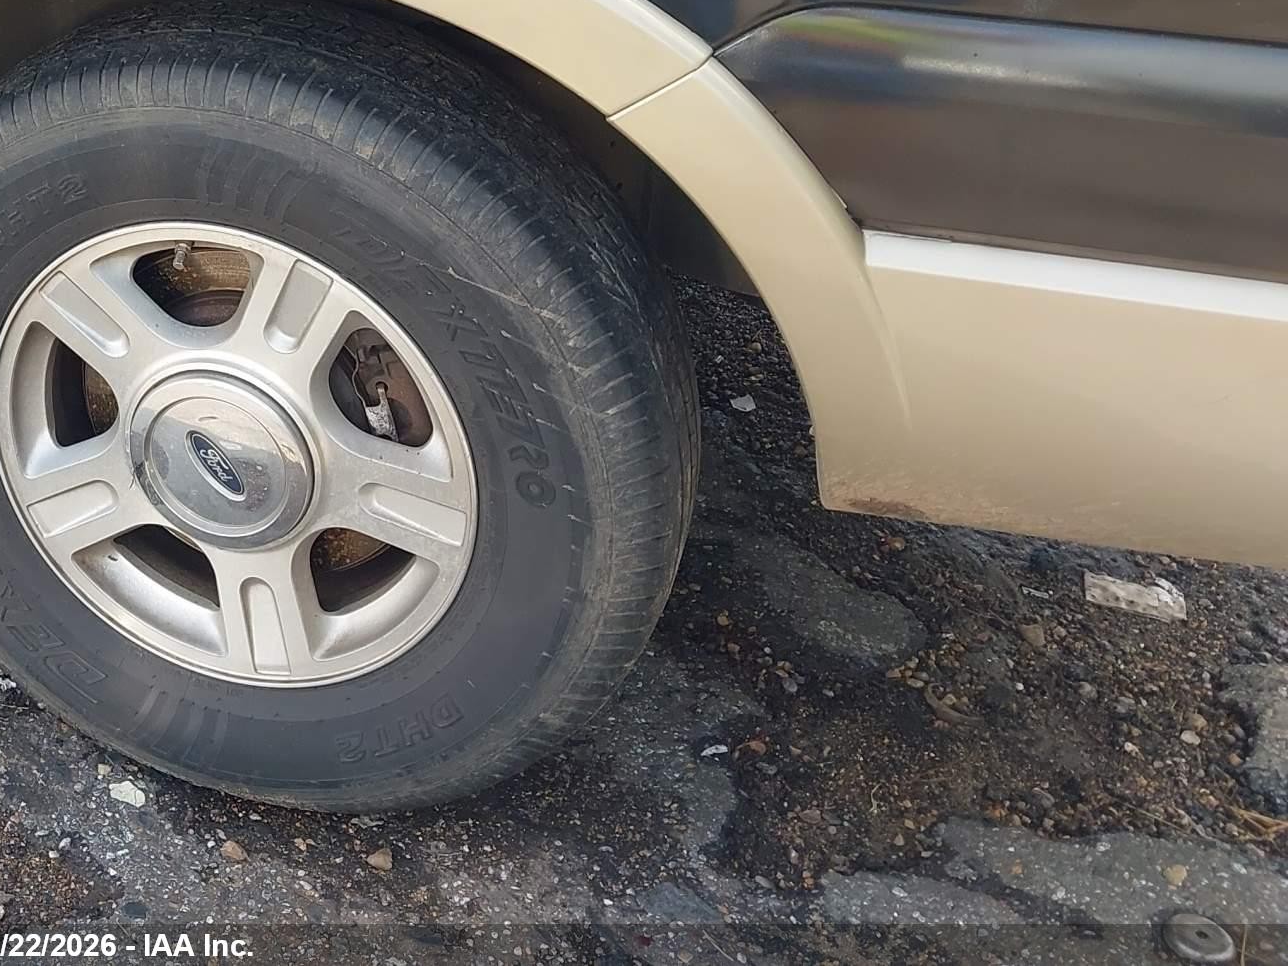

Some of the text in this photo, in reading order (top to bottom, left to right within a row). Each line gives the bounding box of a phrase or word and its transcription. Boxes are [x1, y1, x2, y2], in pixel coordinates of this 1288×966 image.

[328, 208, 558, 509] DEXTERO
[200, 448, 234, 483] Ford
[335, 692, 464, 764] DHT2
